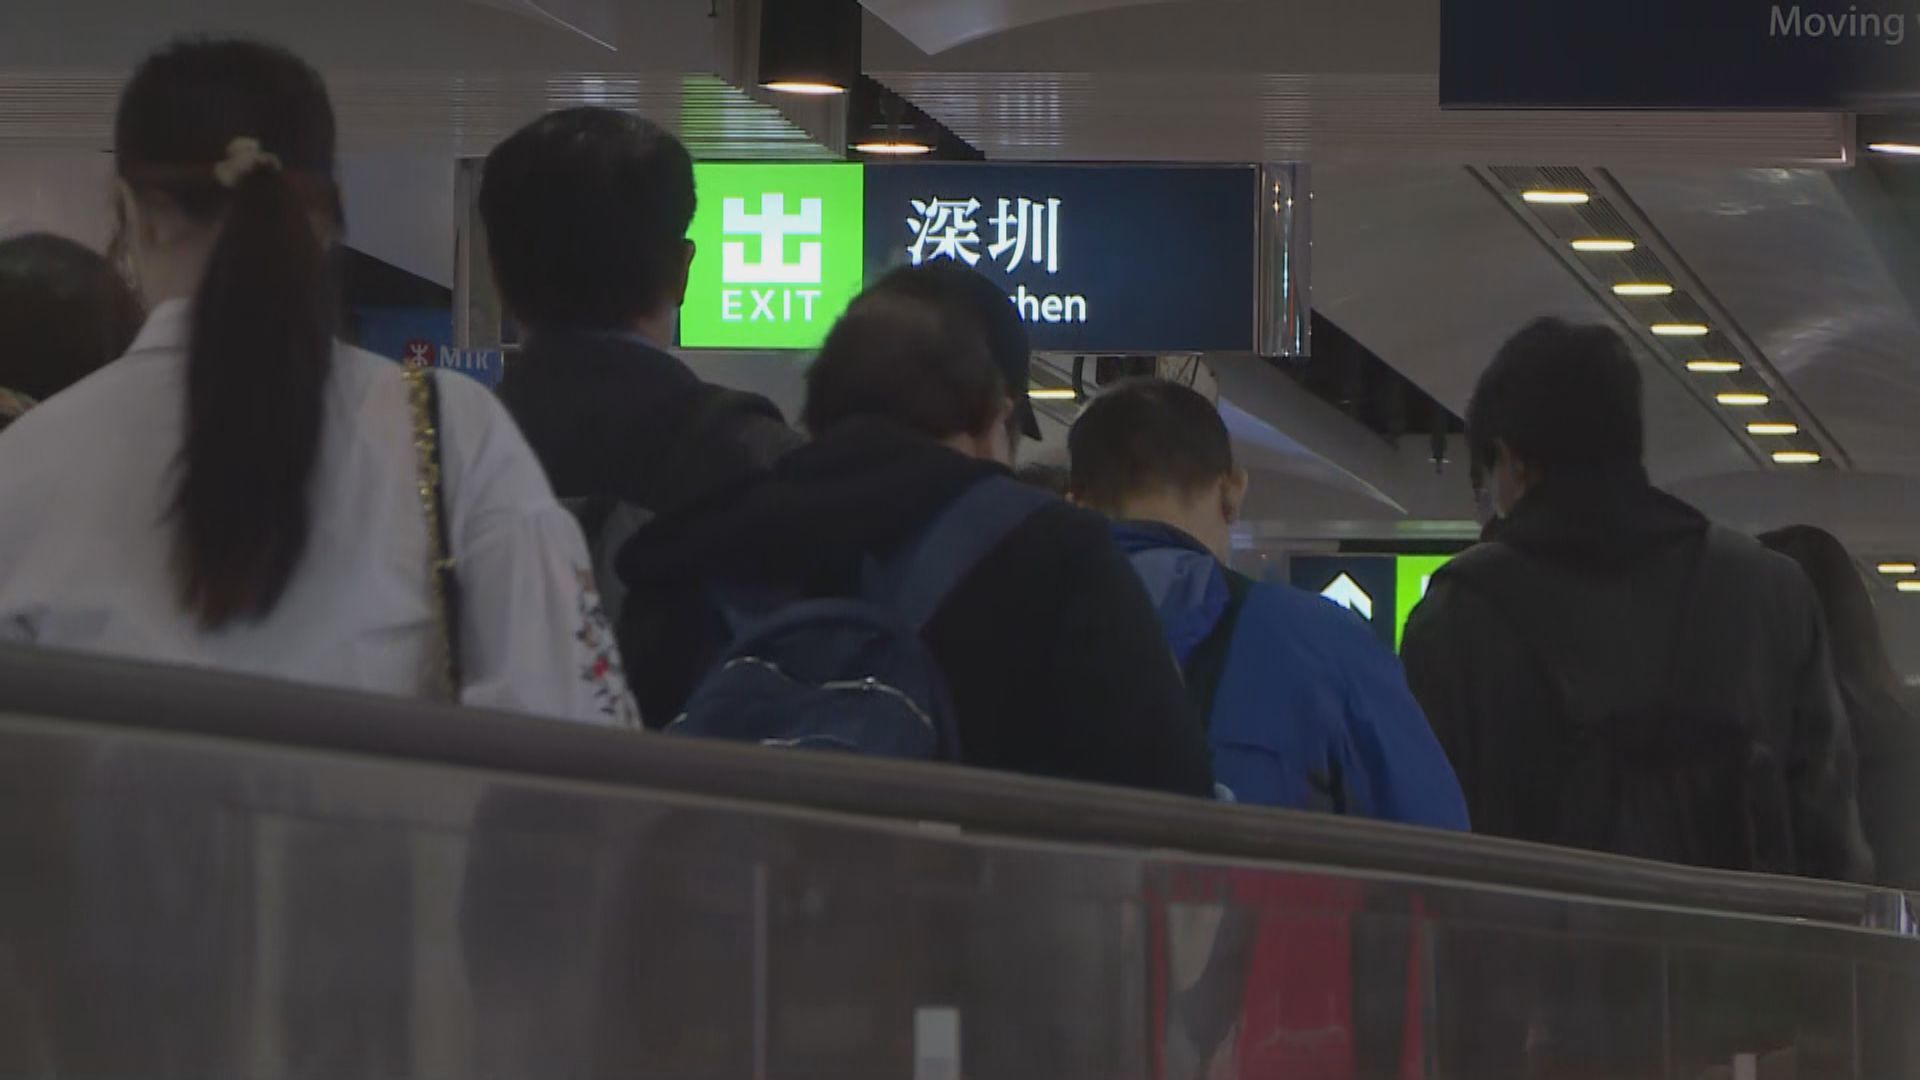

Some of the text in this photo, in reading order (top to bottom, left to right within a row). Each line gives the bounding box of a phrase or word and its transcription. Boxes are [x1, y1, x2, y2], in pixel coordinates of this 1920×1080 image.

[1769, 5, 1905, 45] Moving
[723, 193, 822, 283] 出
[906, 197, 1062, 274] 深圳
[722, 289, 822, 322] EXIT
